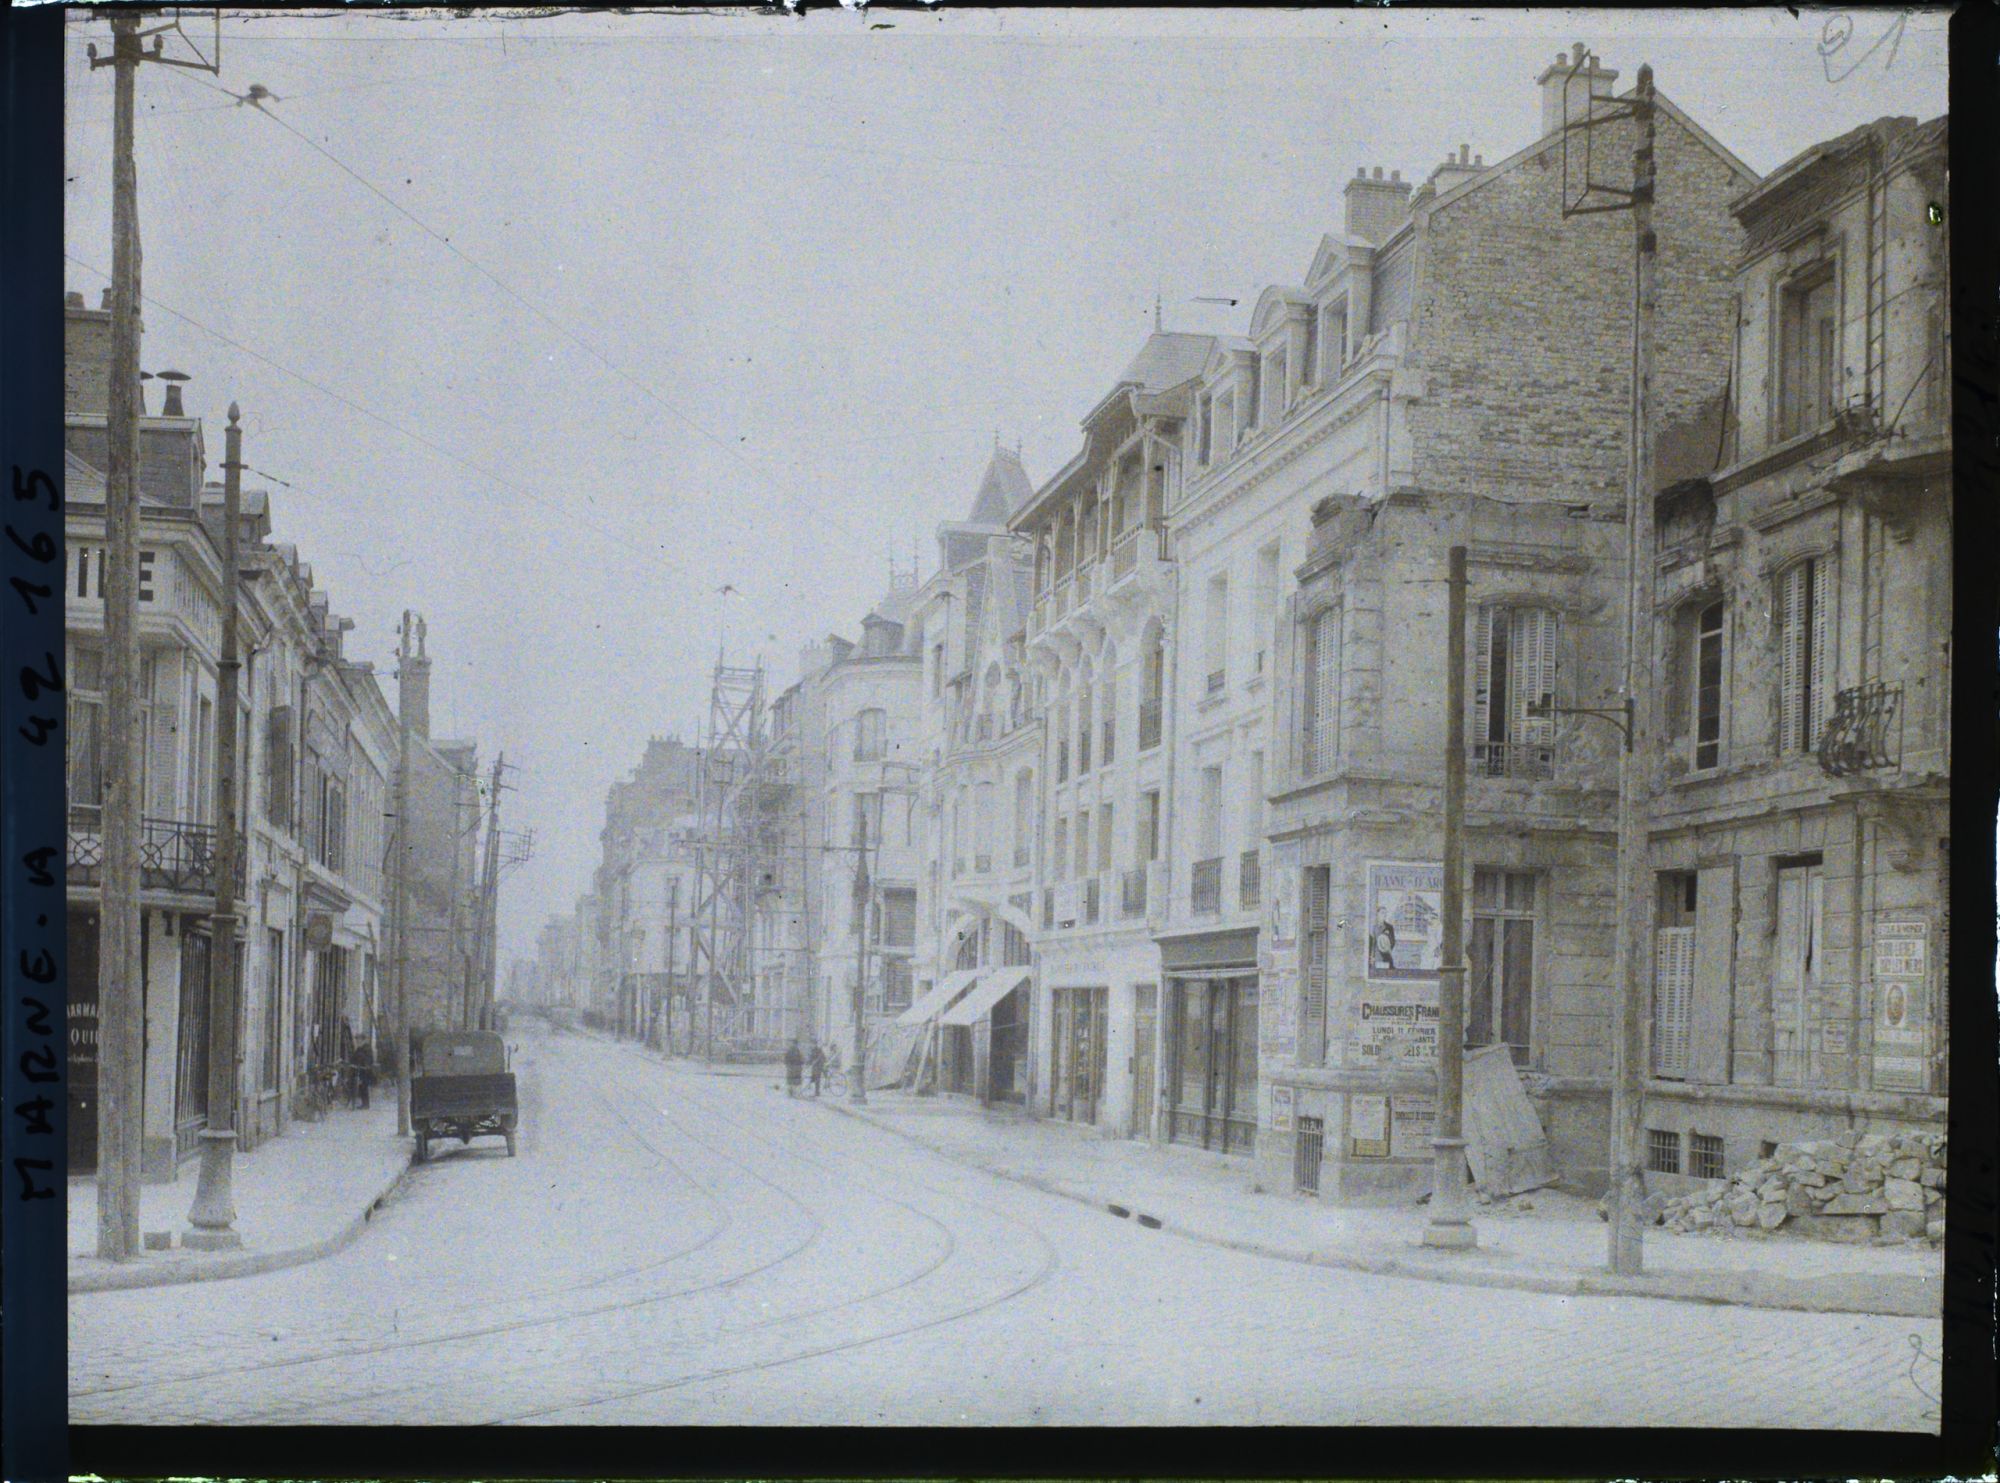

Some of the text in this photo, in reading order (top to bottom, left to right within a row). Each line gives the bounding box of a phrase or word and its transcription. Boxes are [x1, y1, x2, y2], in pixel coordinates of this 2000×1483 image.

[4, 462, 59, 614] 165
[18, 649, 63, 746] 42
[67, 1003, 99, 1018] ARMA
[1372, 1026, 1394, 1034] LUNDI
